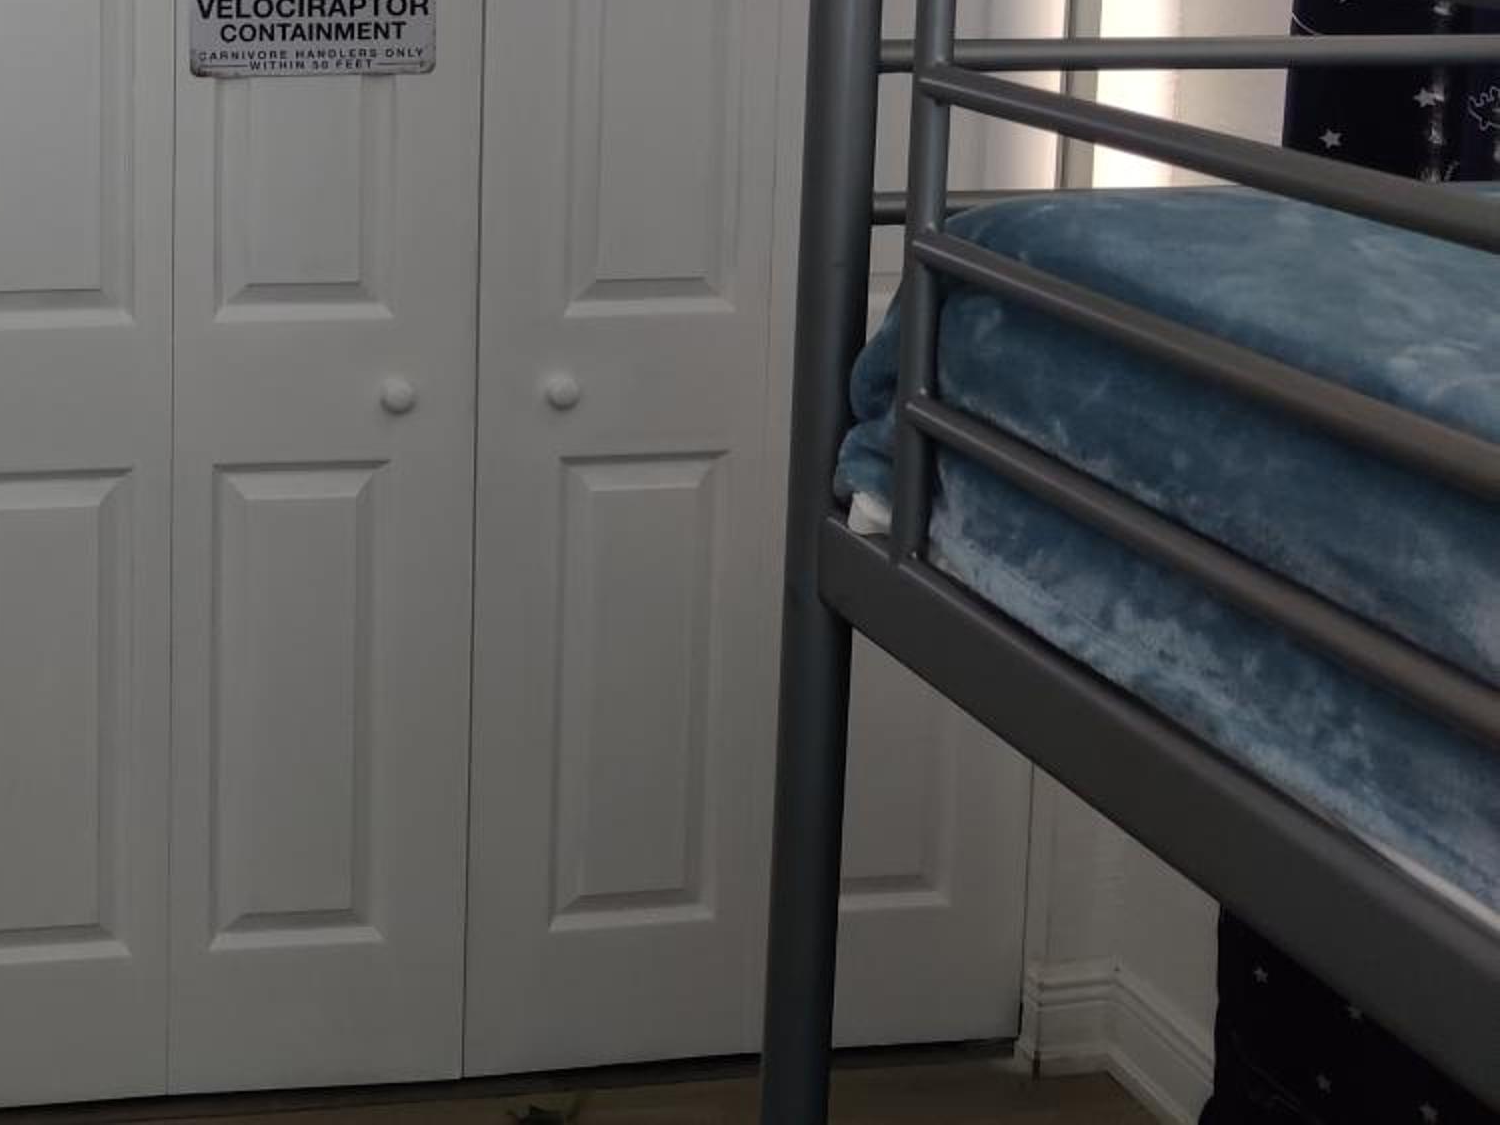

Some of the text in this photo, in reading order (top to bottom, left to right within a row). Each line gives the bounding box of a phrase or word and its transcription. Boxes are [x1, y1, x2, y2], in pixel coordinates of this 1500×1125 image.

[220, 21, 407, 43] CONTAINMENT
[199, 48, 423, 62] CARNIVORE HANDLERS ONLY
[250, 59, 373, 70] WITHIN 50 FEET
